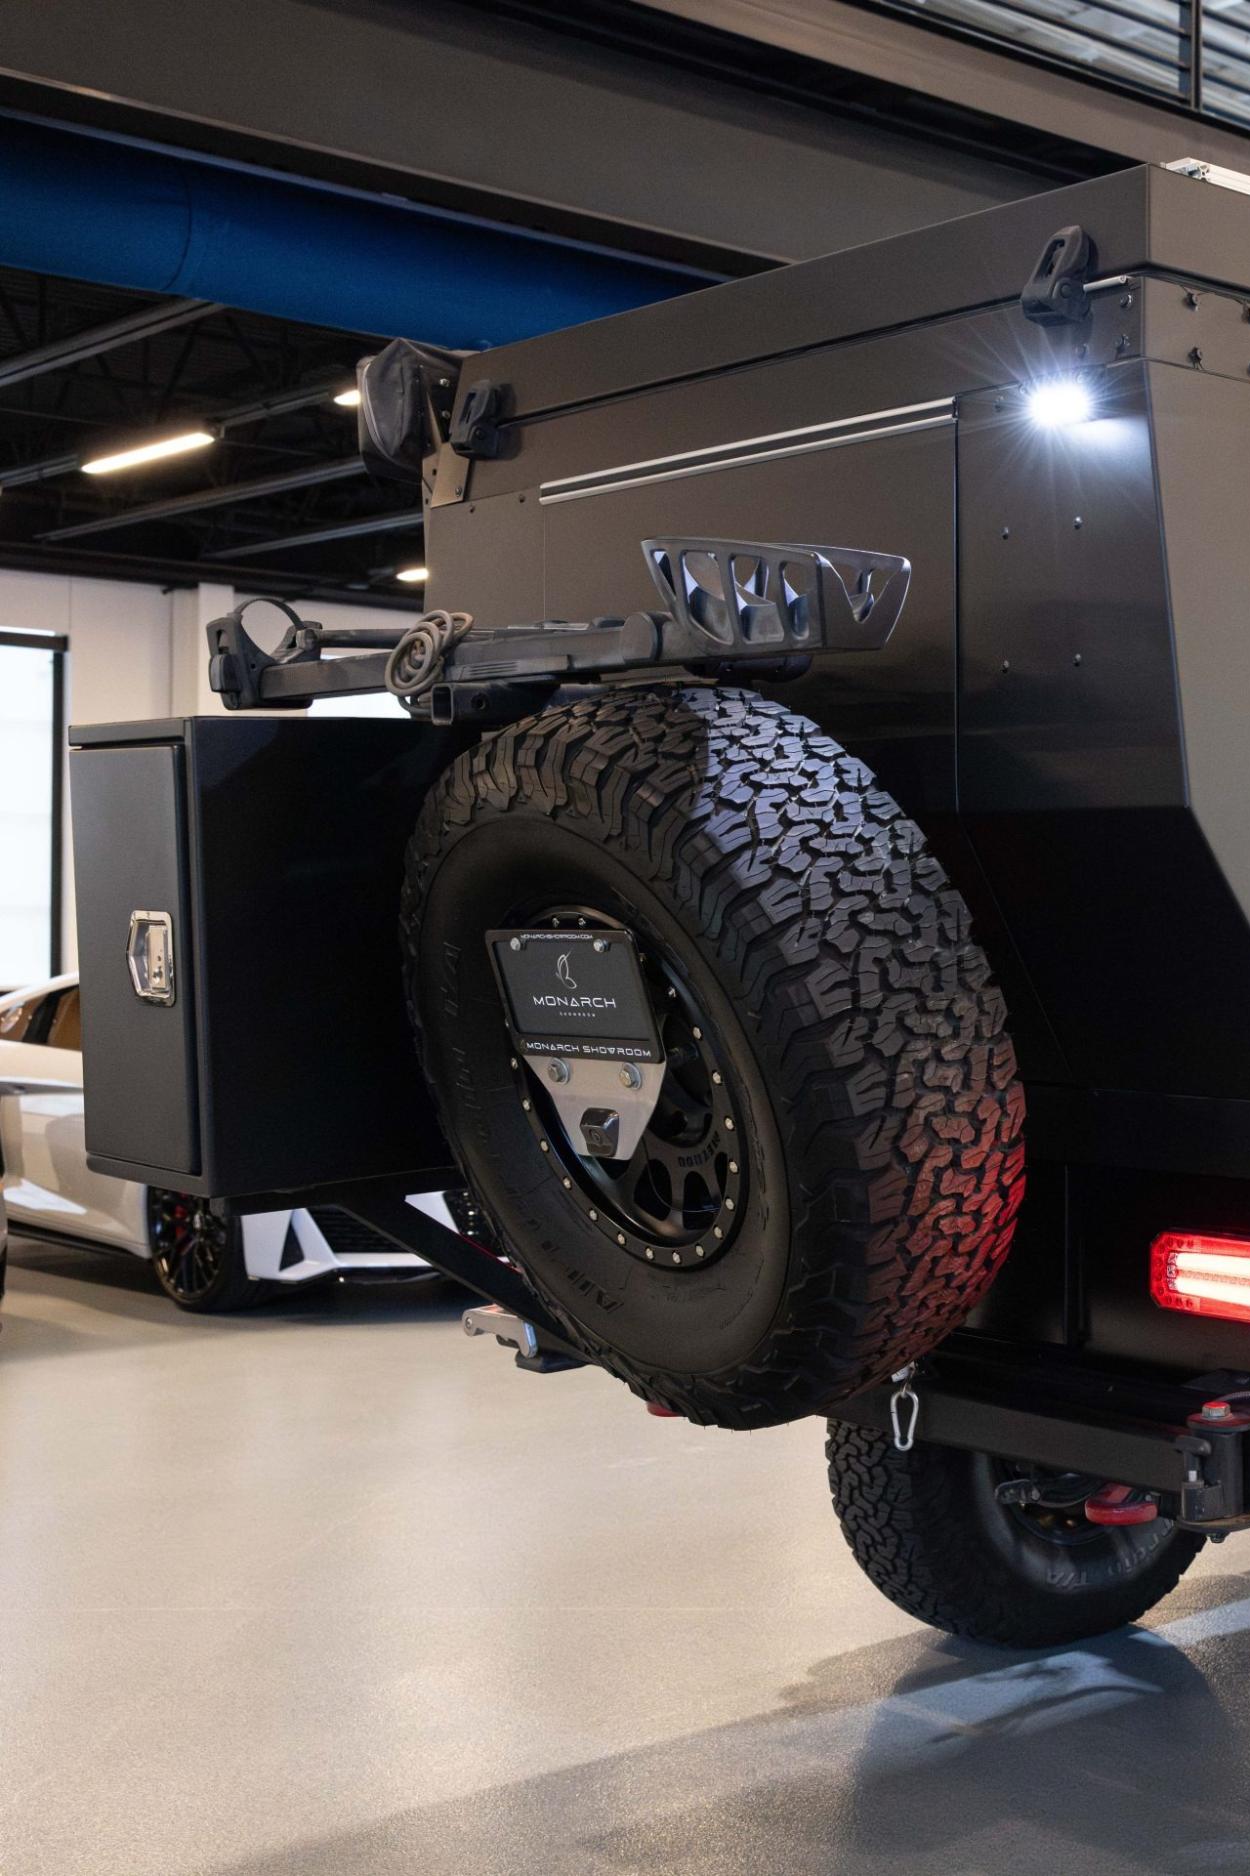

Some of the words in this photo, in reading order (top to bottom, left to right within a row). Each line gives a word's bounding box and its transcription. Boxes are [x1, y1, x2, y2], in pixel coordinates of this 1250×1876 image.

[532, 996, 617, 1009] MONARCH
[526, 1042, 580, 1053] MONARCH
[582, 1045, 652, 1057] SHOWROOM
